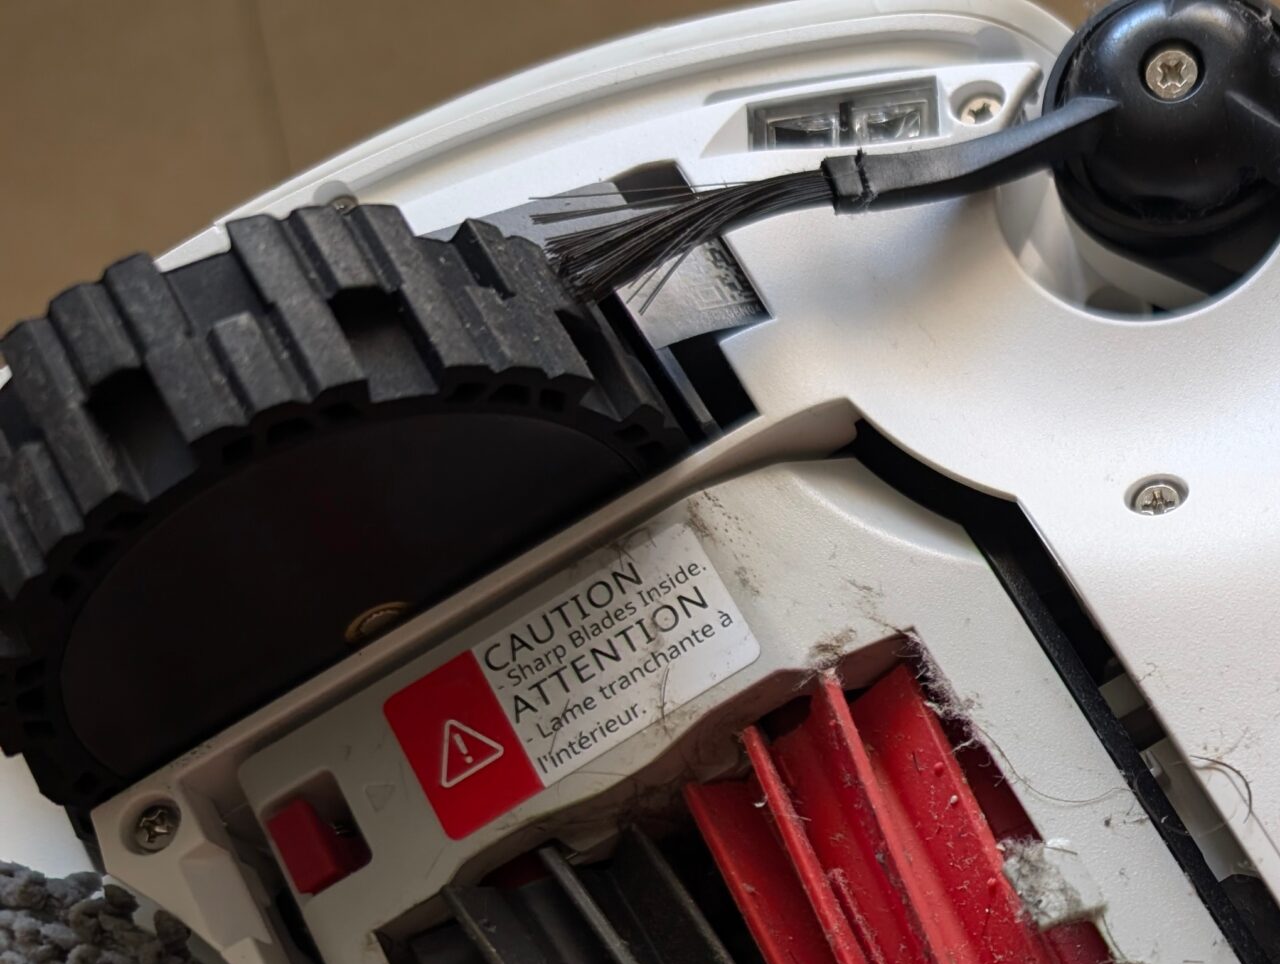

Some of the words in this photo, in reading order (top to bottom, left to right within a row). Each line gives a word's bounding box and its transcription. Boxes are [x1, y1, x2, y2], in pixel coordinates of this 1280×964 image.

[483, 561, 643, 672] CAUTION
[505, 643, 567, 687] Sharp
[567, 601, 637, 649] Blades
[637, 563, 707, 608] Inside.
[512, 585, 709, 724] ATTENTION
[535, 697, 597, 739] Lame
[598, 622, 716, 701] tranchante
[717, 609, 734, 628] à
[536, 702, 647, 775] l'intérieur.
